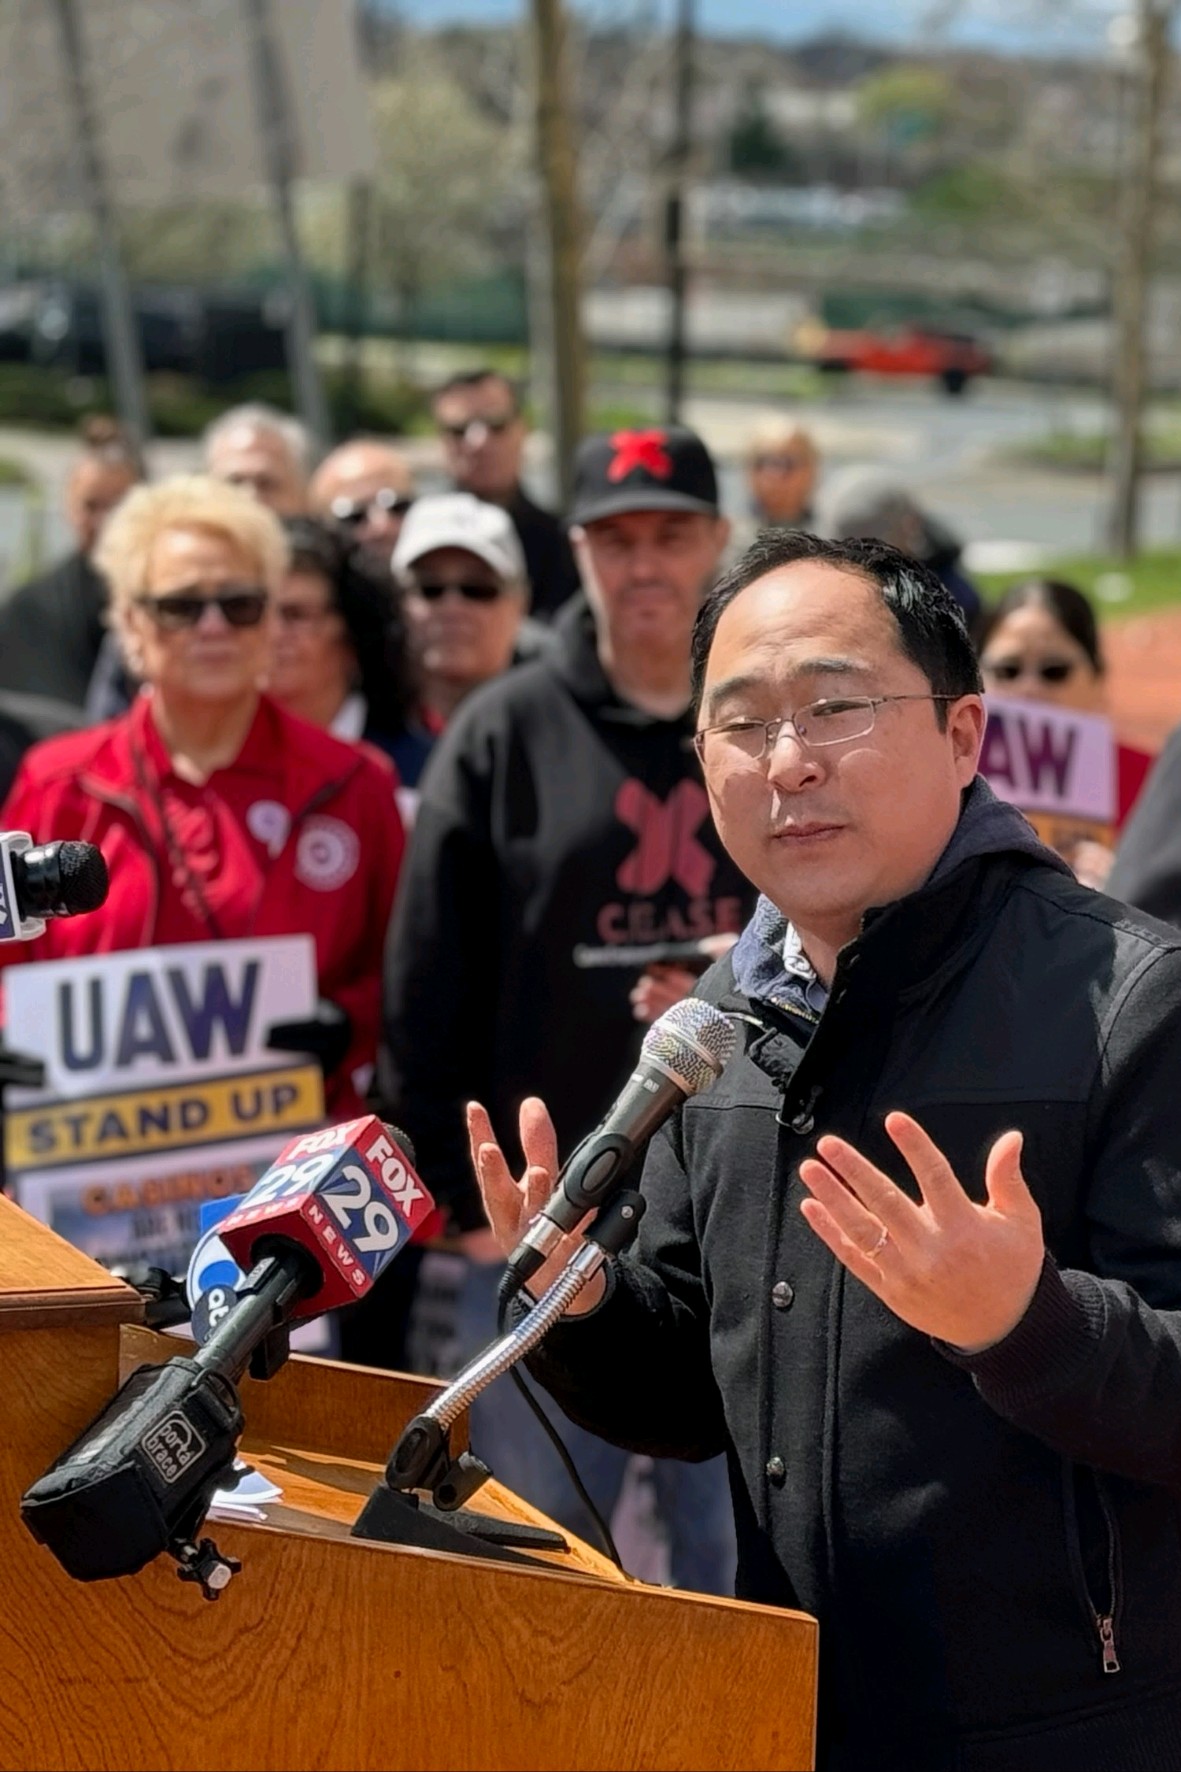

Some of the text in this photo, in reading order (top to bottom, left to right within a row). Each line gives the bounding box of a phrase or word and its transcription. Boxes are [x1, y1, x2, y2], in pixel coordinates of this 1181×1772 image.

[979, 711, 1078, 798] AW
[597, 897, 742, 944] CEASE
[58, 958, 261, 1072] UAW
[27, 1083, 298, 1152] STAND UP
[284, 1121, 358, 1161] FOX
[239, 1152, 336, 1211] 29
[364, 1134, 426, 1218] FOX
[225, 1198, 302, 1228] NEWS
[320, 1164, 400, 1253] 29
[307, 1203, 367, 1287] NEWS
[148, 1437, 179, 1476] brace
[159, 1422, 195, 1467] porta
